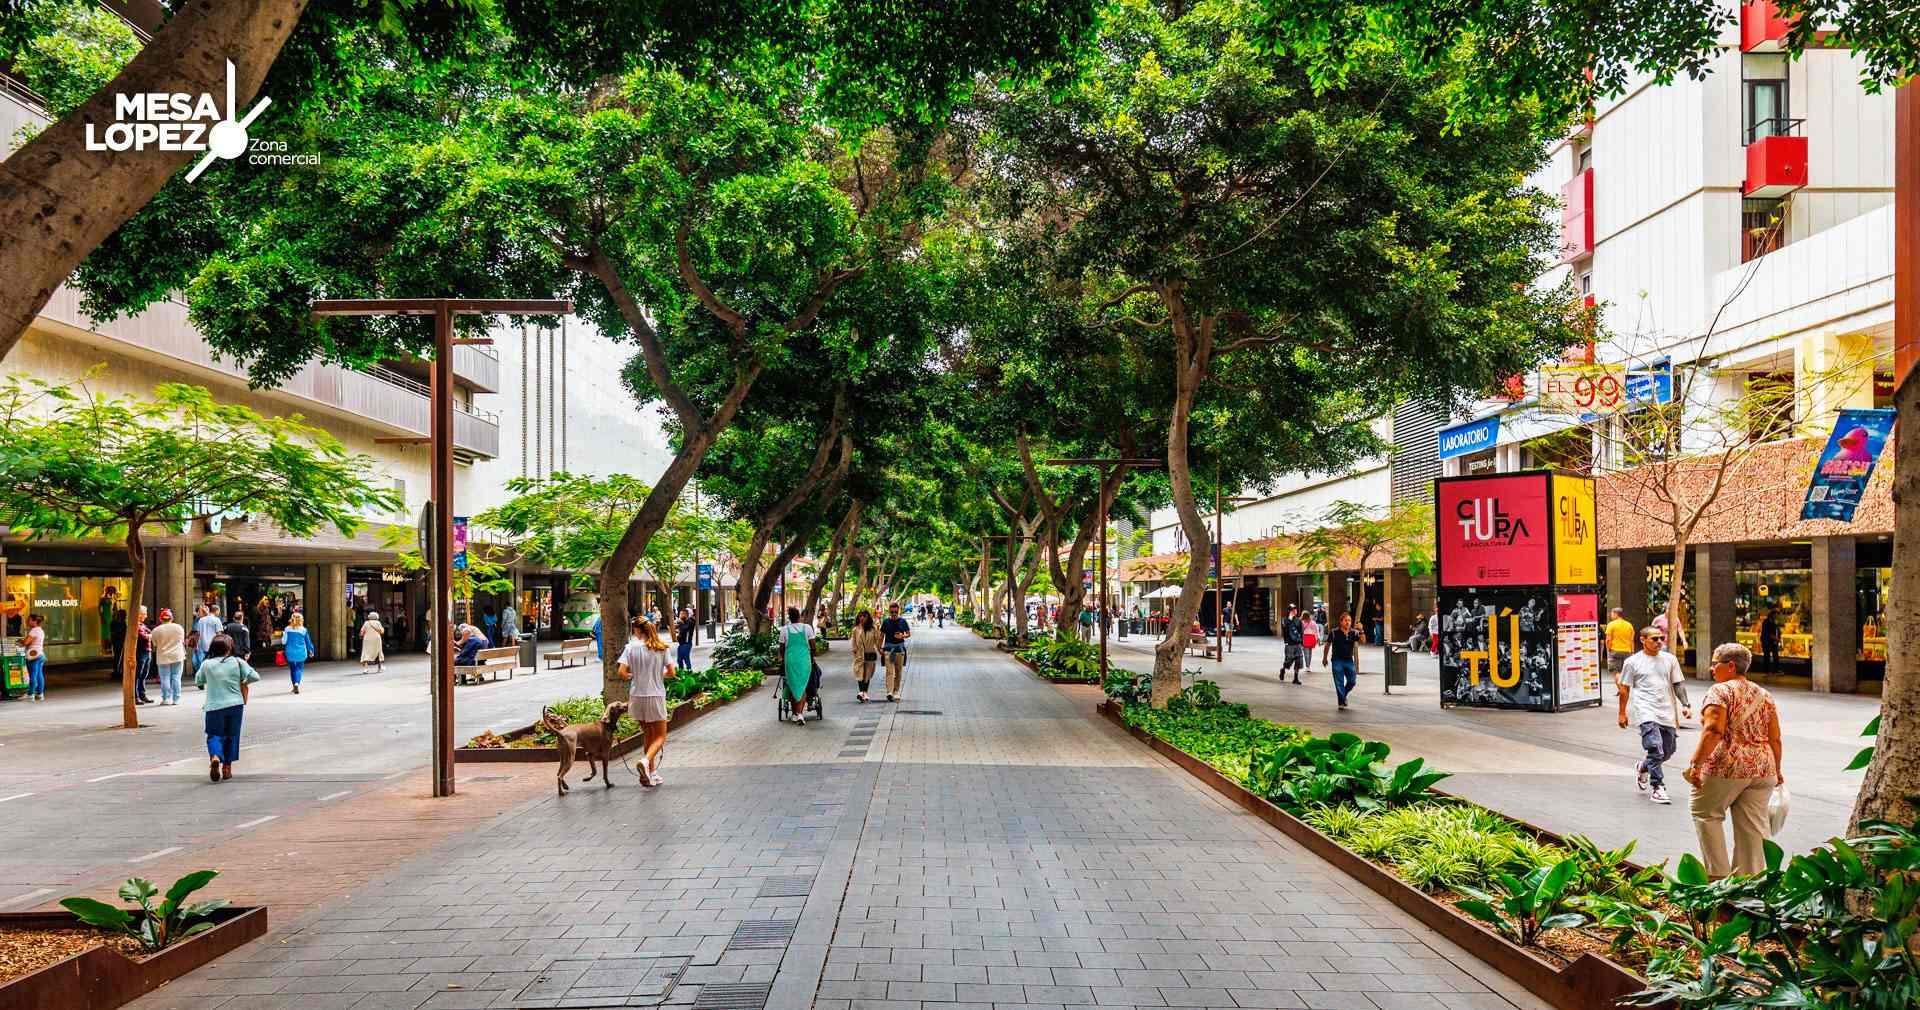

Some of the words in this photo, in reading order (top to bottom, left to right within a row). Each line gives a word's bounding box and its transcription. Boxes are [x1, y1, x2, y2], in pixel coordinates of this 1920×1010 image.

[1547, 381, 1566, 393] EL
[1574, 375, 1620, 407] 99
[1442, 426, 1489, 452] LABORATORIO
[34, 599, 61, 608] MICHAEL
[62, 599, 79, 608] KORS
[1460, 607, 1520, 688] TÚ
